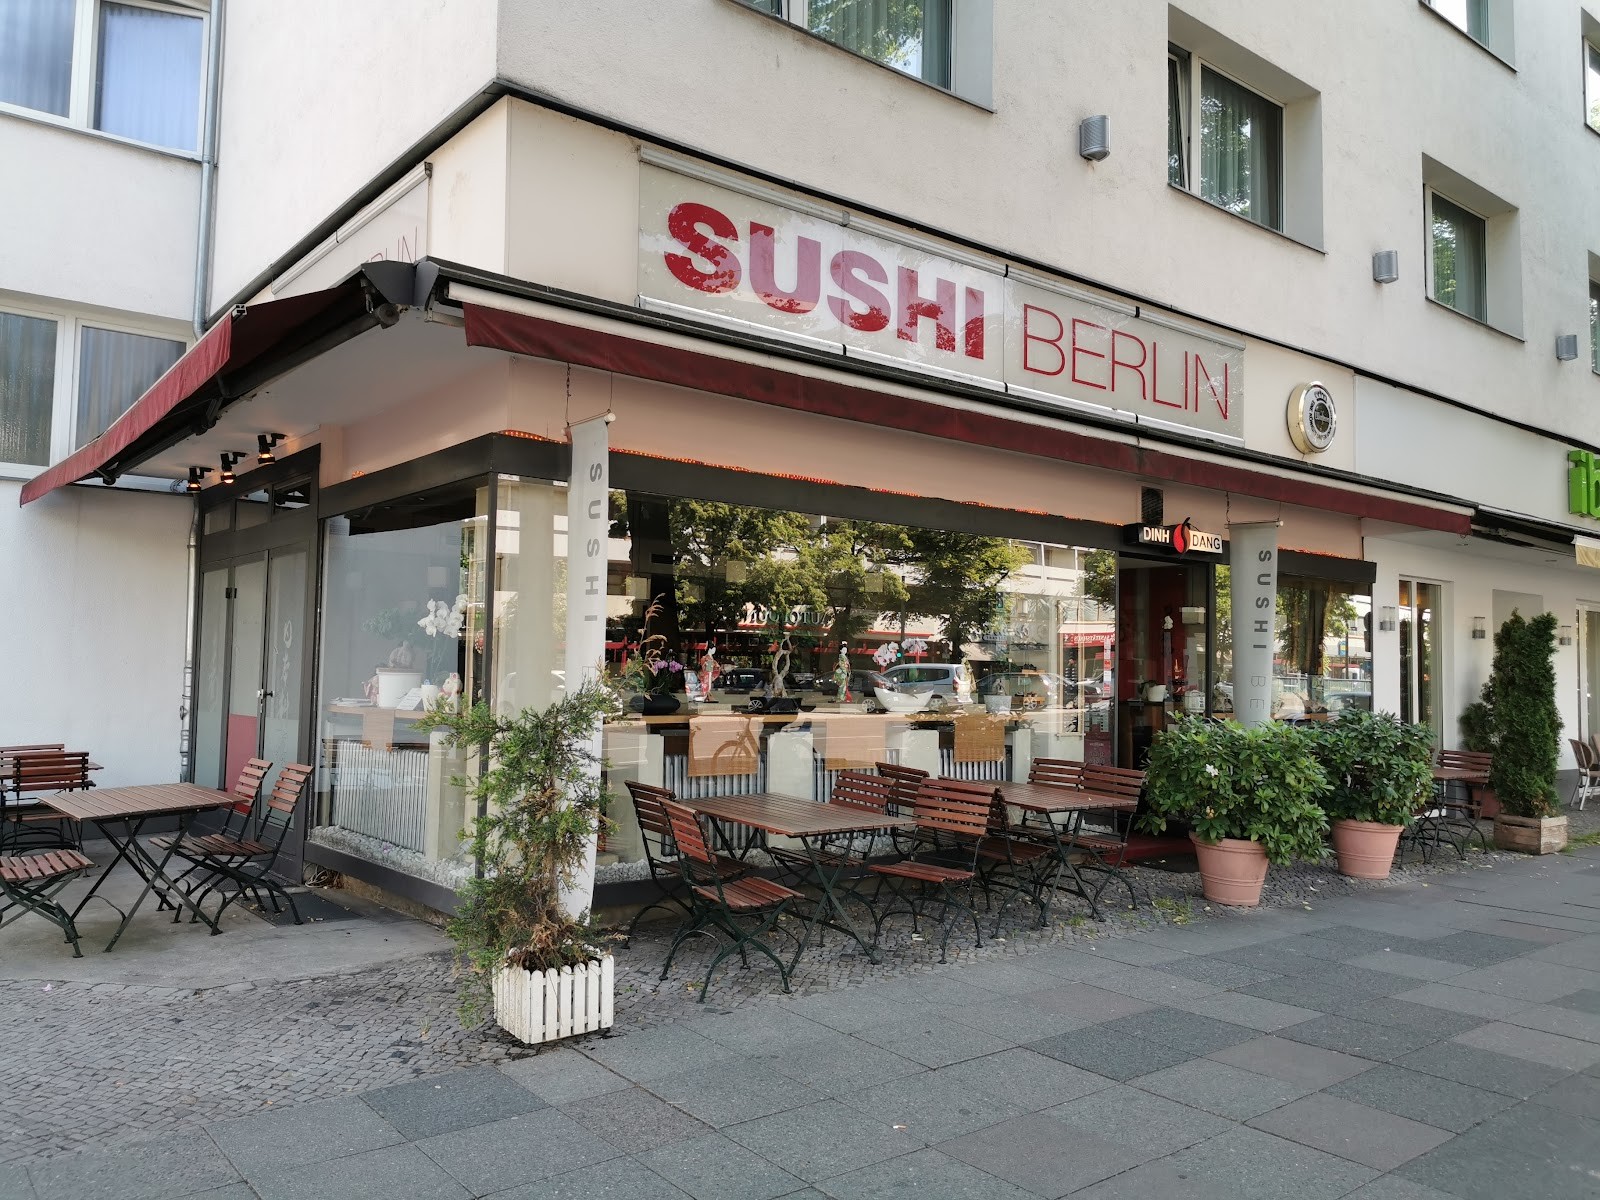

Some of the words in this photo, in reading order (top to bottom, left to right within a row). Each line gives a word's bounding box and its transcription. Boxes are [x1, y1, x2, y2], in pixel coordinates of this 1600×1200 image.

[664, 202, 985, 360] SUSHI
[1023, 303, 1229, 420] BERLIN
[584, 462, 603, 622] SUSHI
[1143, 526, 1170, 543] DINH
[1192, 534, 1220, 550] DANG
[1253, 550, 1272, 649] SUSHI
